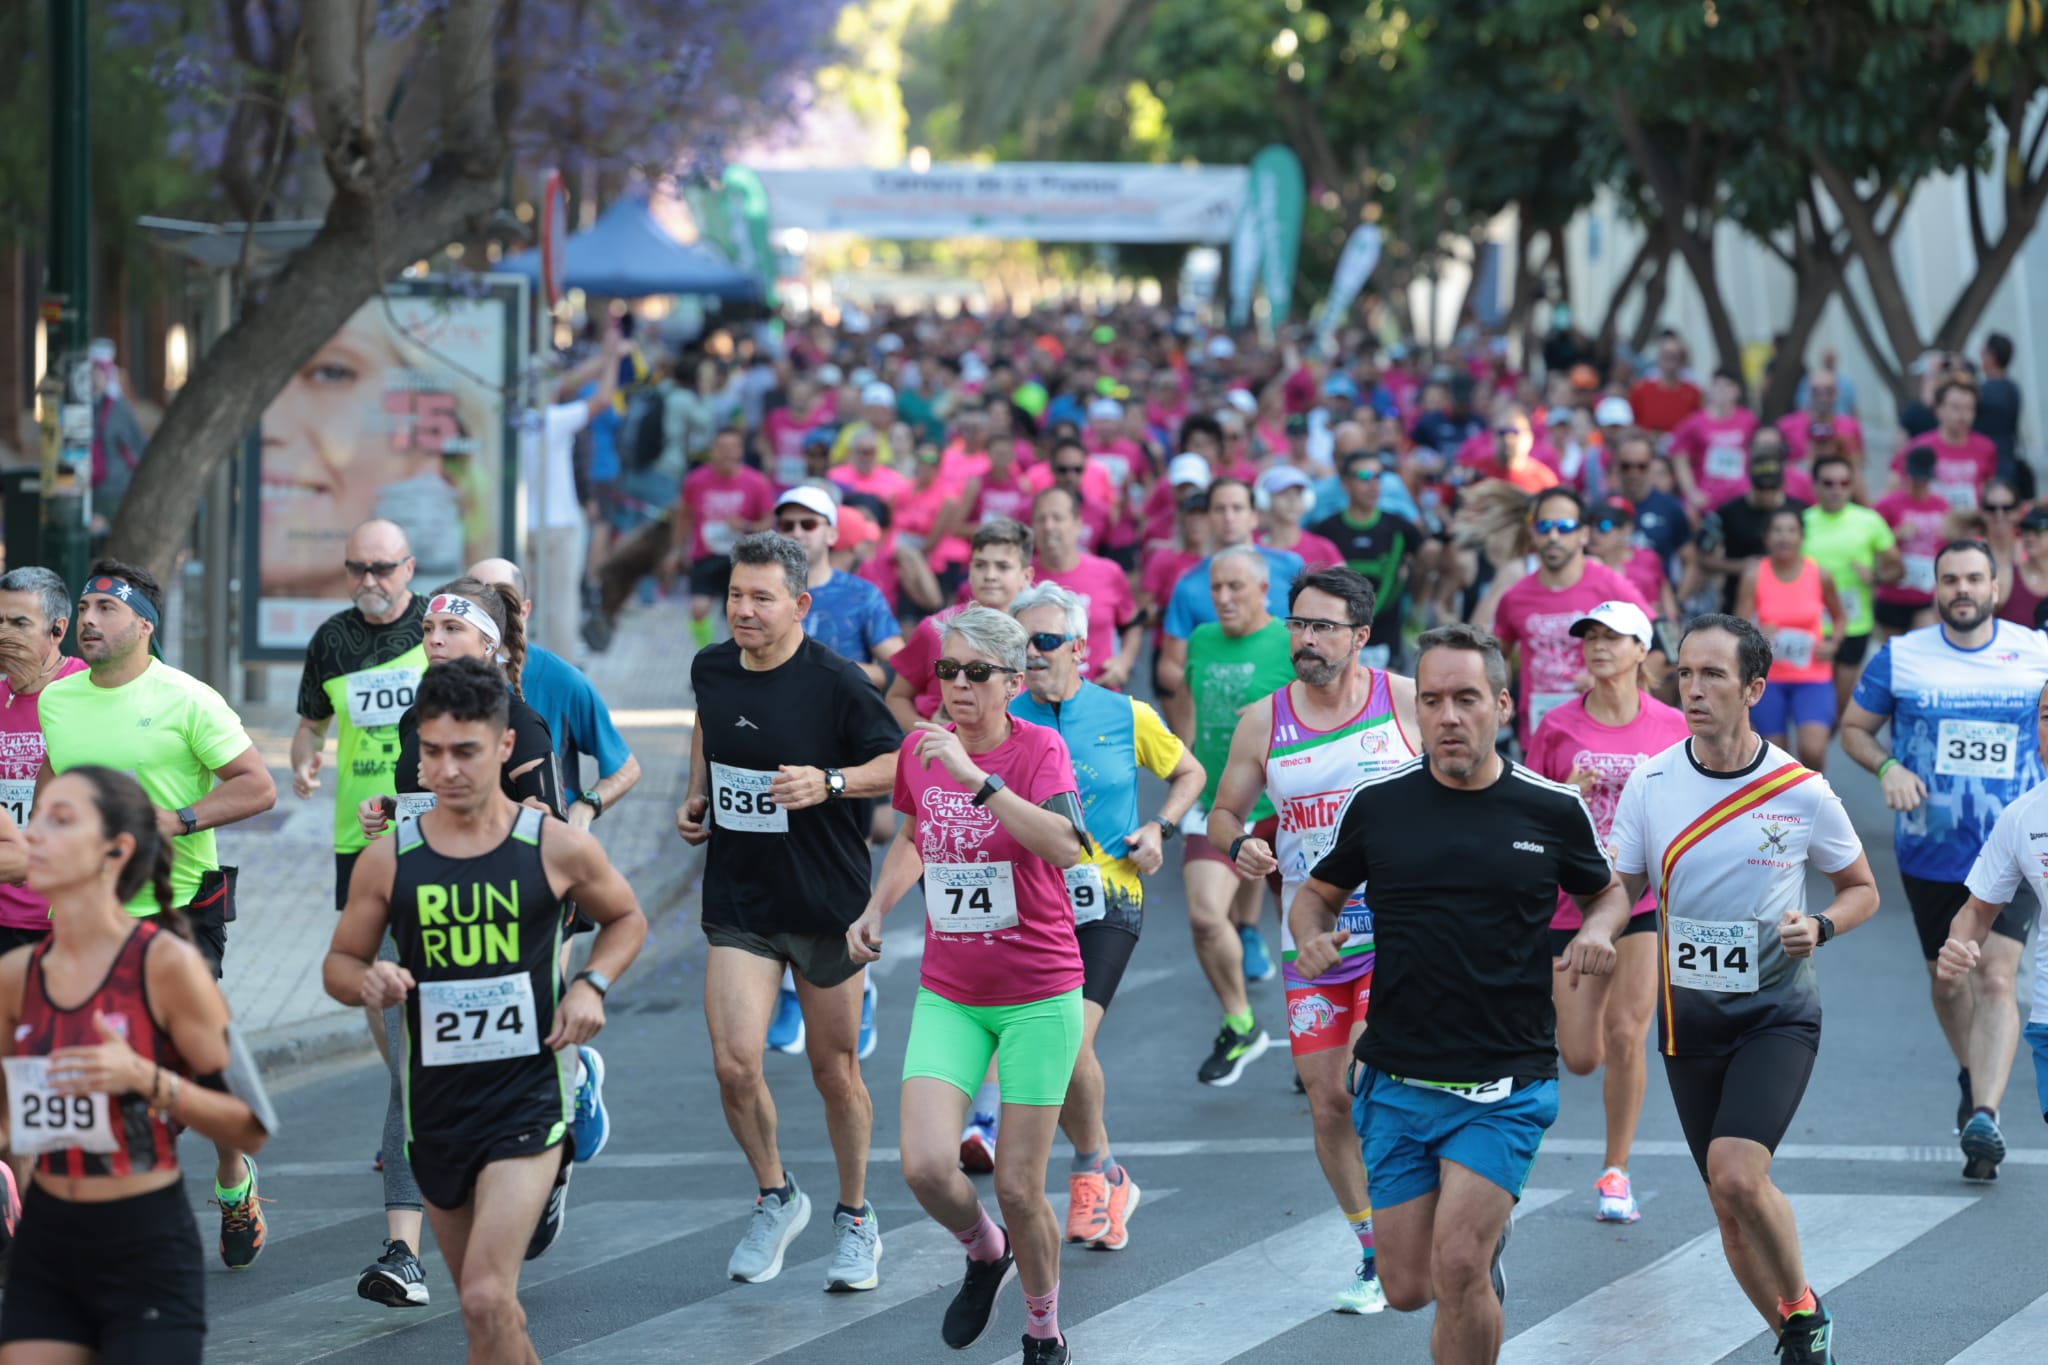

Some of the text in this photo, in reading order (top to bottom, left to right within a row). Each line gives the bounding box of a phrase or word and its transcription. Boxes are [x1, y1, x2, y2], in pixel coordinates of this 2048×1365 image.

[356, 687, 414, 711] 700
[1917, 688, 1939, 708] 31
[1948, 740, 2007, 762] 339
[720, 787, 776, 815] 636
[1513, 841, 1544, 853] adidas
[417, 879, 519, 926] RUN
[945, 888, 992, 914] 74
[422, 922, 520, 968] RUN
[1678, 943, 1749, 973] 214
[436, 1005, 523, 1042] 274
[23, 1094, 94, 1129] 299
